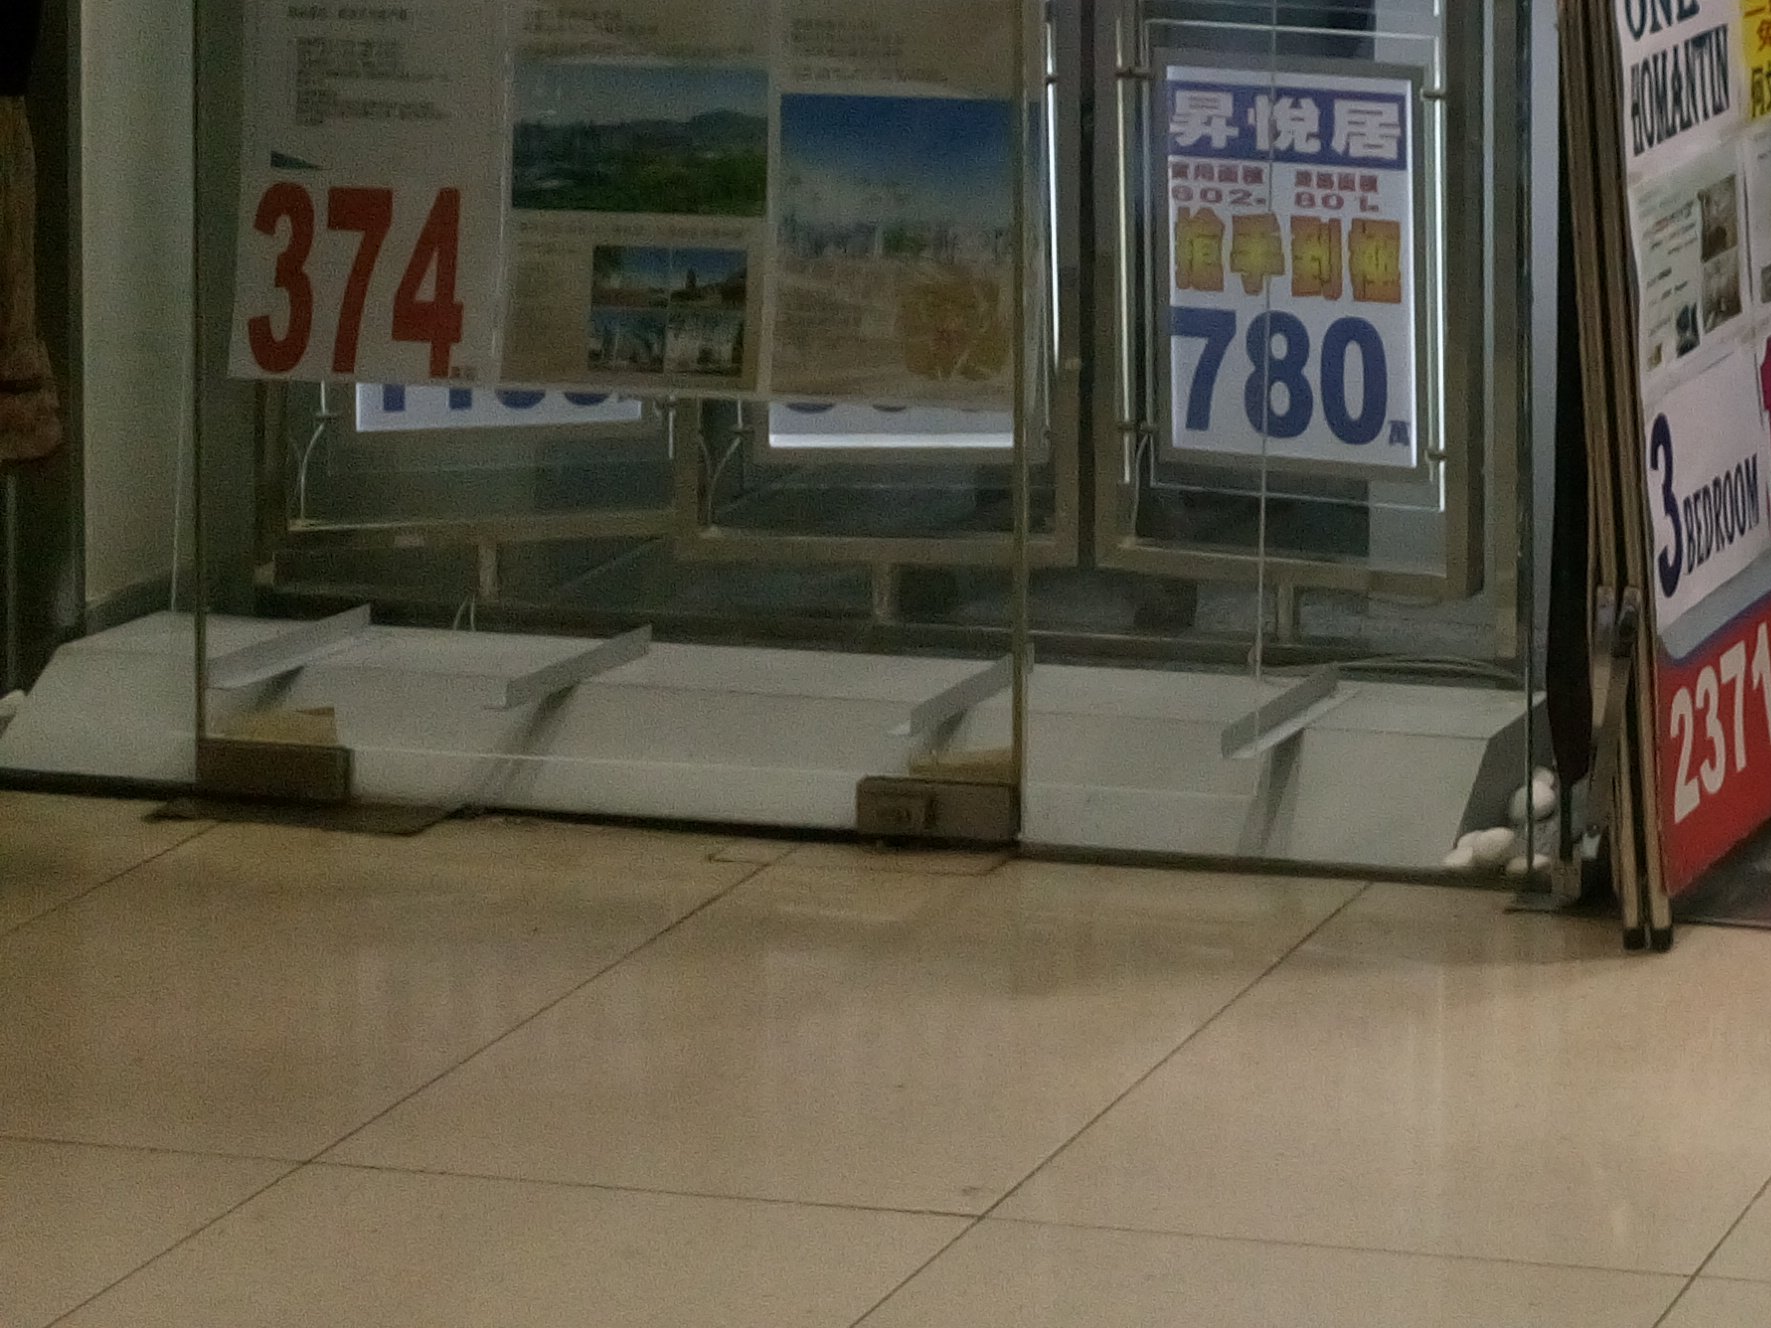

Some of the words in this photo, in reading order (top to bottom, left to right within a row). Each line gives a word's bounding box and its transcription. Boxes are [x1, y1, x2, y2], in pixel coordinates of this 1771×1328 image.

[1169, 89, 1402, 160] 昇悅居
[1630, 24, 1731, 157] HOMANTIN
[246, 181, 464, 379] 374
[1650, 412, 1684, 599] 3
[1682, 452, 1760, 577] BEDROOM
